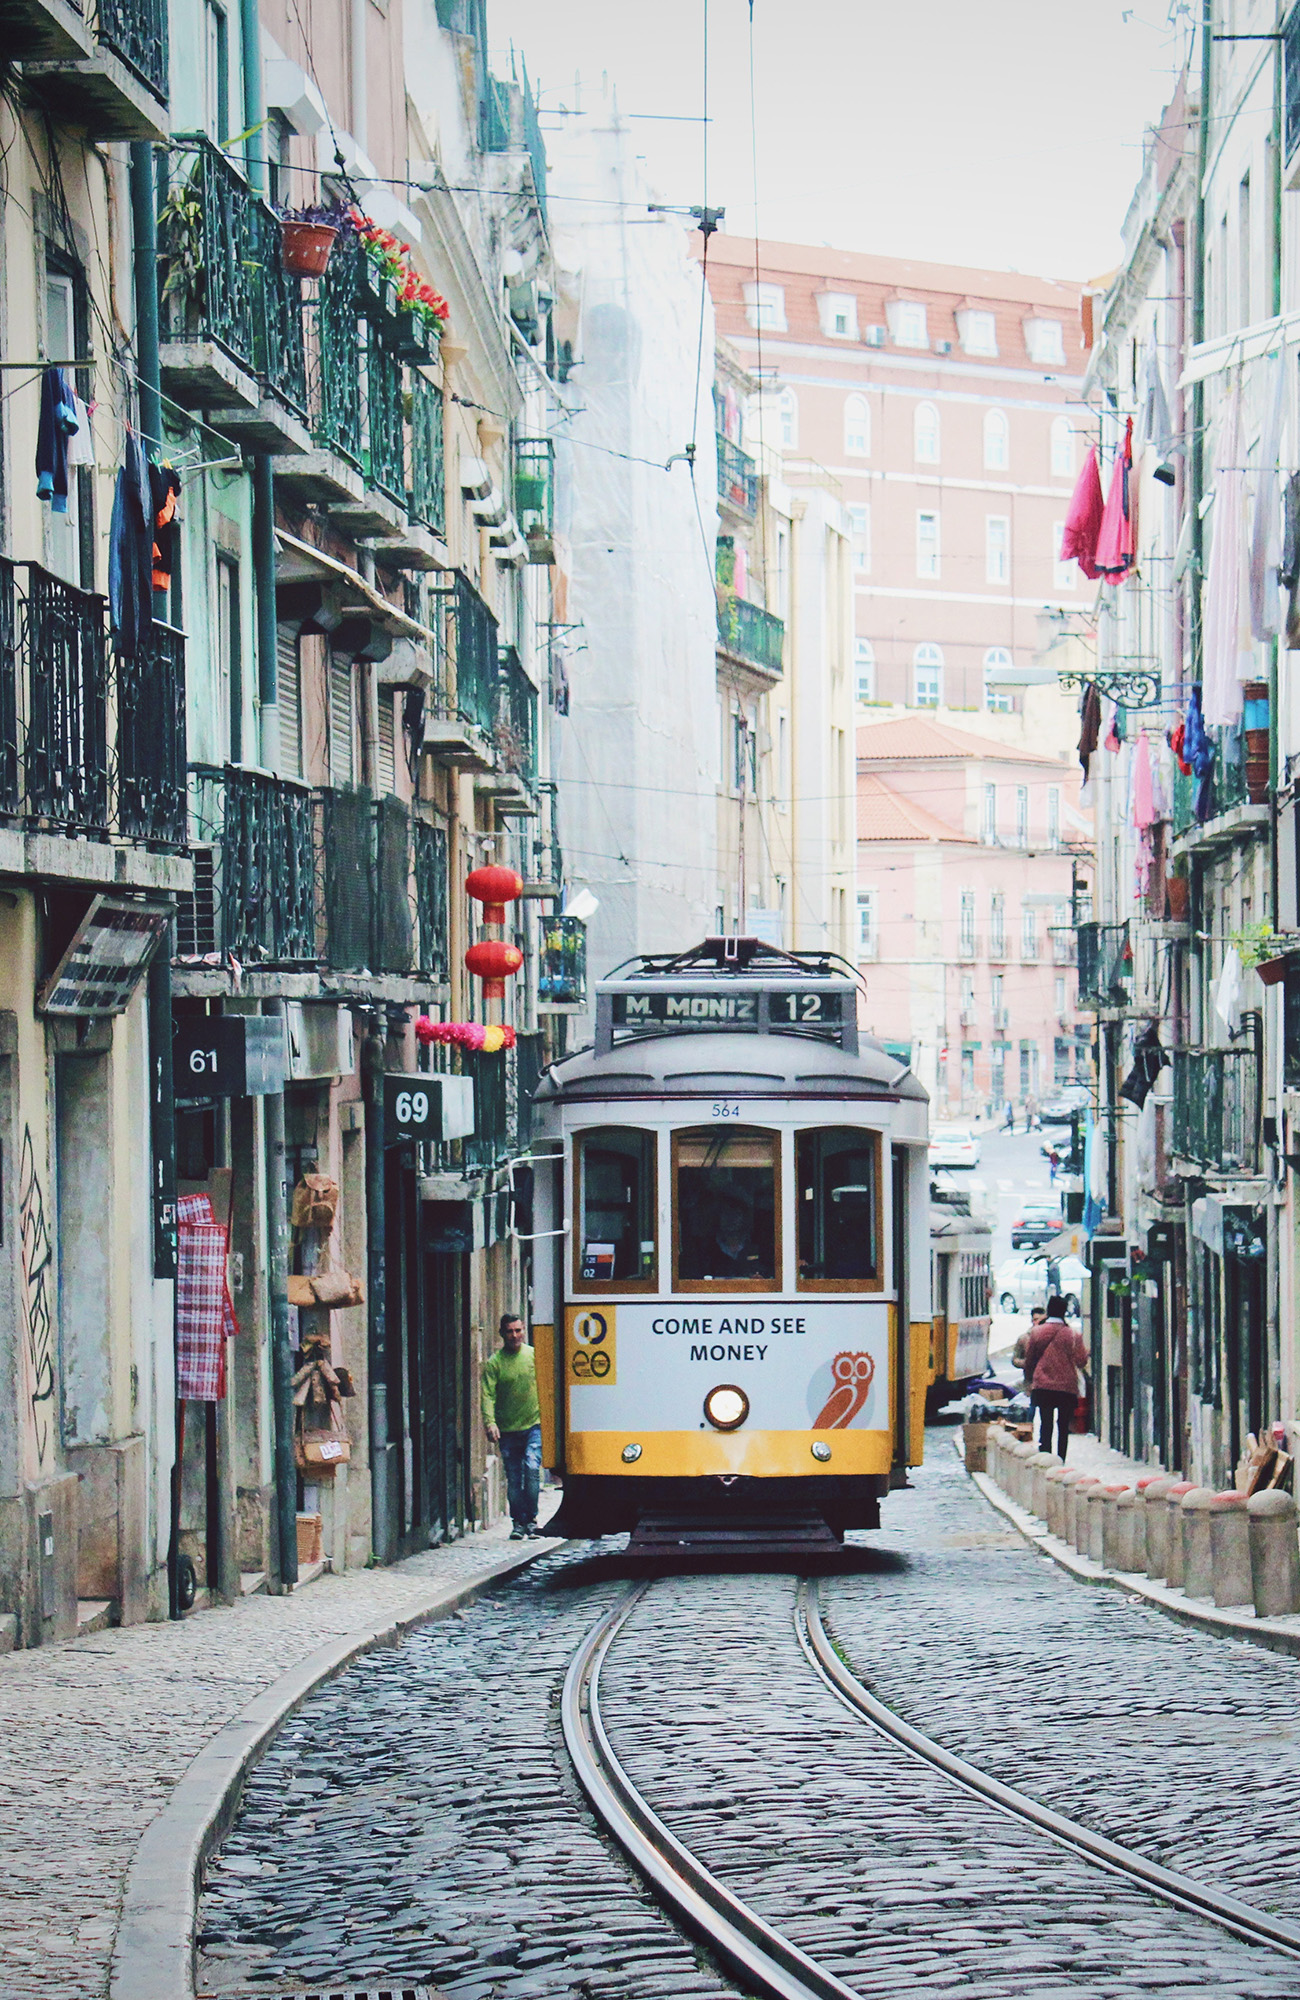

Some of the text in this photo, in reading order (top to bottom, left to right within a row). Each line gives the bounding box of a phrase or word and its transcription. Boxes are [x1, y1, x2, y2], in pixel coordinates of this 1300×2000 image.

[626, 995, 756, 1018] M. MONIZ
[786, 994, 822, 1021] 12
[189, 1049, 218, 1073] 61
[395, 1091, 429, 1123] 69
[711, 1103, 740, 1117] 564
[583, 1268, 596, 1278] 02
[651, 1318, 806, 1335] COME AND SEE
[690, 1345, 768, 1361] MONEY
